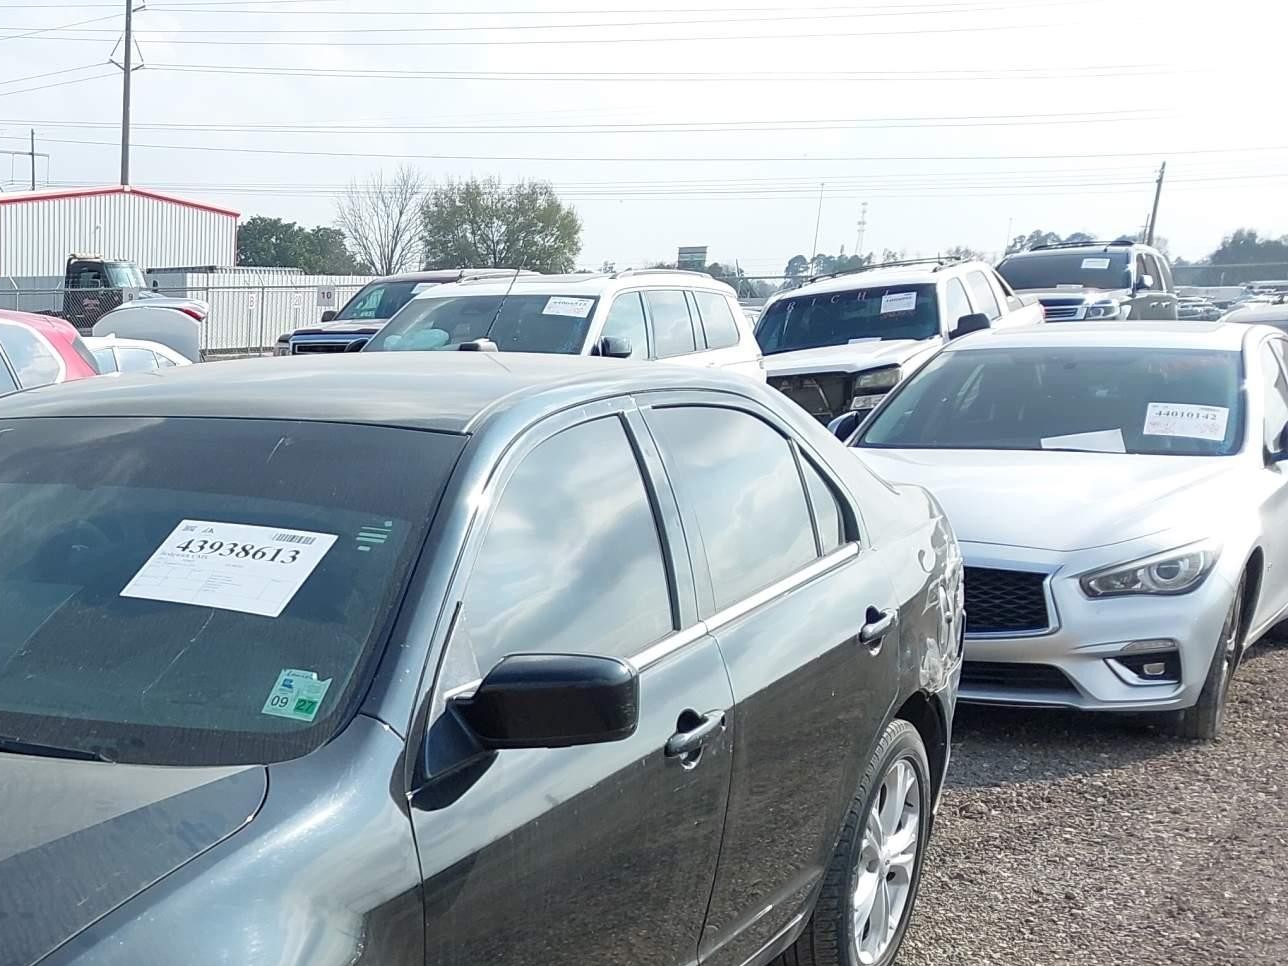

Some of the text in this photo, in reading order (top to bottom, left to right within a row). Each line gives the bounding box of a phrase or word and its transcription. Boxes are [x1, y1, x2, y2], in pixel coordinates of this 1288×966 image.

[321, 291, 332, 300] 10
[1155, 410, 1216, 420] 44010142
[176, 538, 300, 564] 43938613
[271, 695, 289, 708] 09
[295, 699, 317, 712] 27
